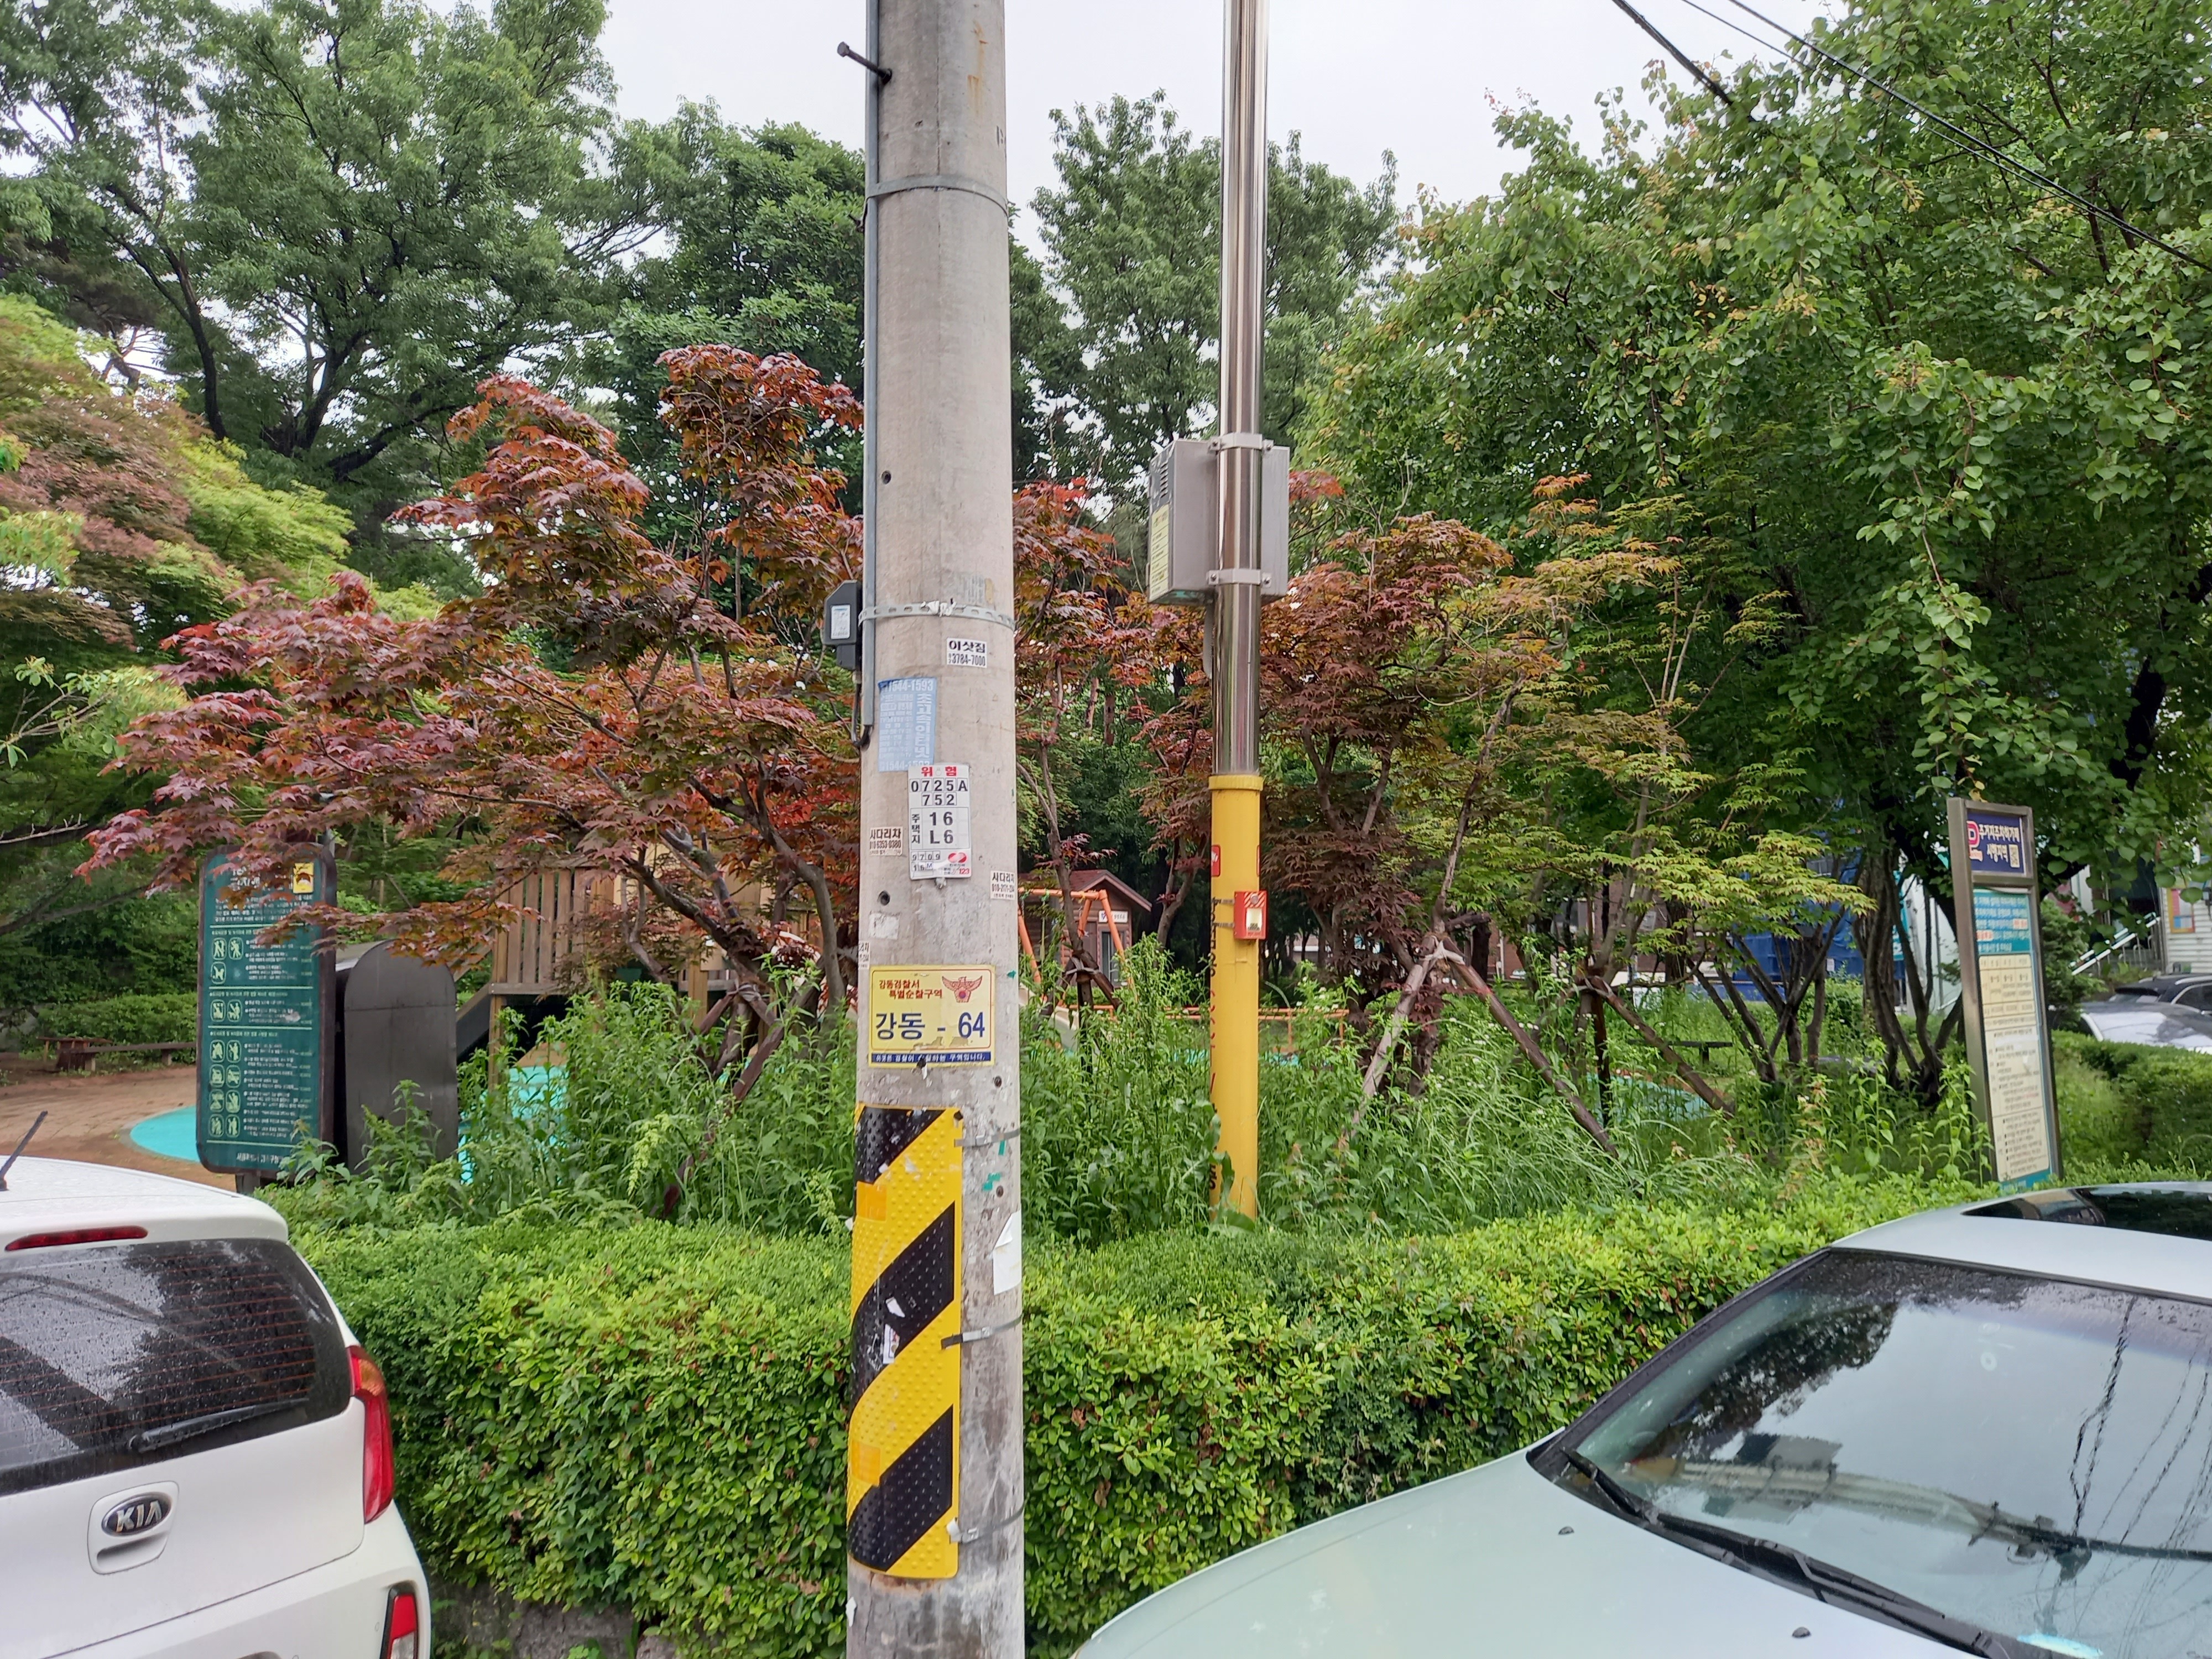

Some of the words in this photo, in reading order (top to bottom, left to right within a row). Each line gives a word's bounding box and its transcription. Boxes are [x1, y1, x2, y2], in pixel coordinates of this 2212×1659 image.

[949, 640, 985, 653] 이삿짐
[914, 692, 932, 758] 초고속인터넷
[911, 780, 968, 792] 0725A
[922, 794, 955, 806] 752
[929, 811, 953, 826] 16
[870, 828, 901, 840] 사다리차
[911, 813, 920, 844] 주택지
[930, 830, 954, 844] L6
[879, 979, 920, 989] 강동경찰서
[889, 989, 942, 1000] 특별순찰구역
[875, 1012, 926, 1040] 강동
[958, 1011, 985, 1039] 64
[116, 1500, 163, 1533] KIA
